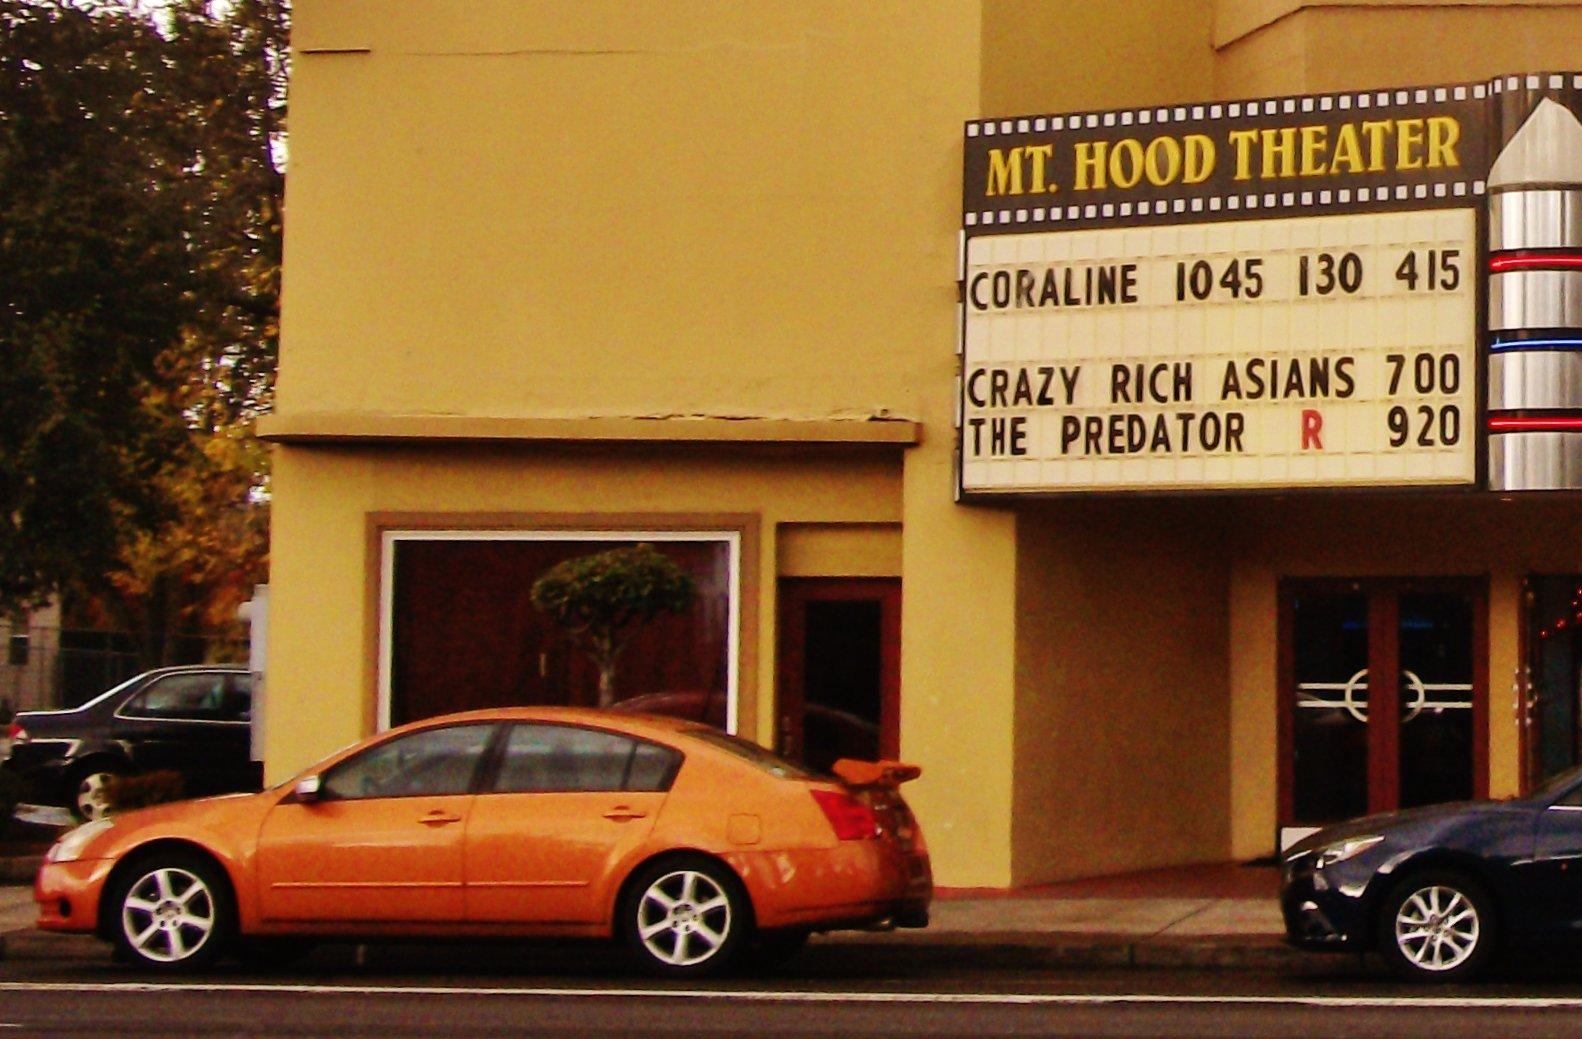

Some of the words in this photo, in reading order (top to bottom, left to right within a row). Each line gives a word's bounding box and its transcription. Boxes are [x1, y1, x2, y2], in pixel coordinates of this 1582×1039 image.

[986, 144, 1057, 196] MT.
[1074, 135, 1215, 190] HOOD
[1229, 116, 1459, 180] THEATER
[971, 265, 1137, 310] CORALINE
[1177, 259, 1262, 301] 1045
[1300, 253, 1362, 295] 130
[1396, 250, 1459, 290] 415
[968, 366, 1080, 407] CRAZY
[1112, 363, 1191, 403] RICH
[1222, 357, 1354, 400] ASIANS
[1387, 353, 1459, 395] 700
[969, 417, 1026, 456] THE
[1062, 412, 1243, 454] PREDATOR
[1303, 411, 1322, 449] R
[1388, 405, 1459, 447] 920
